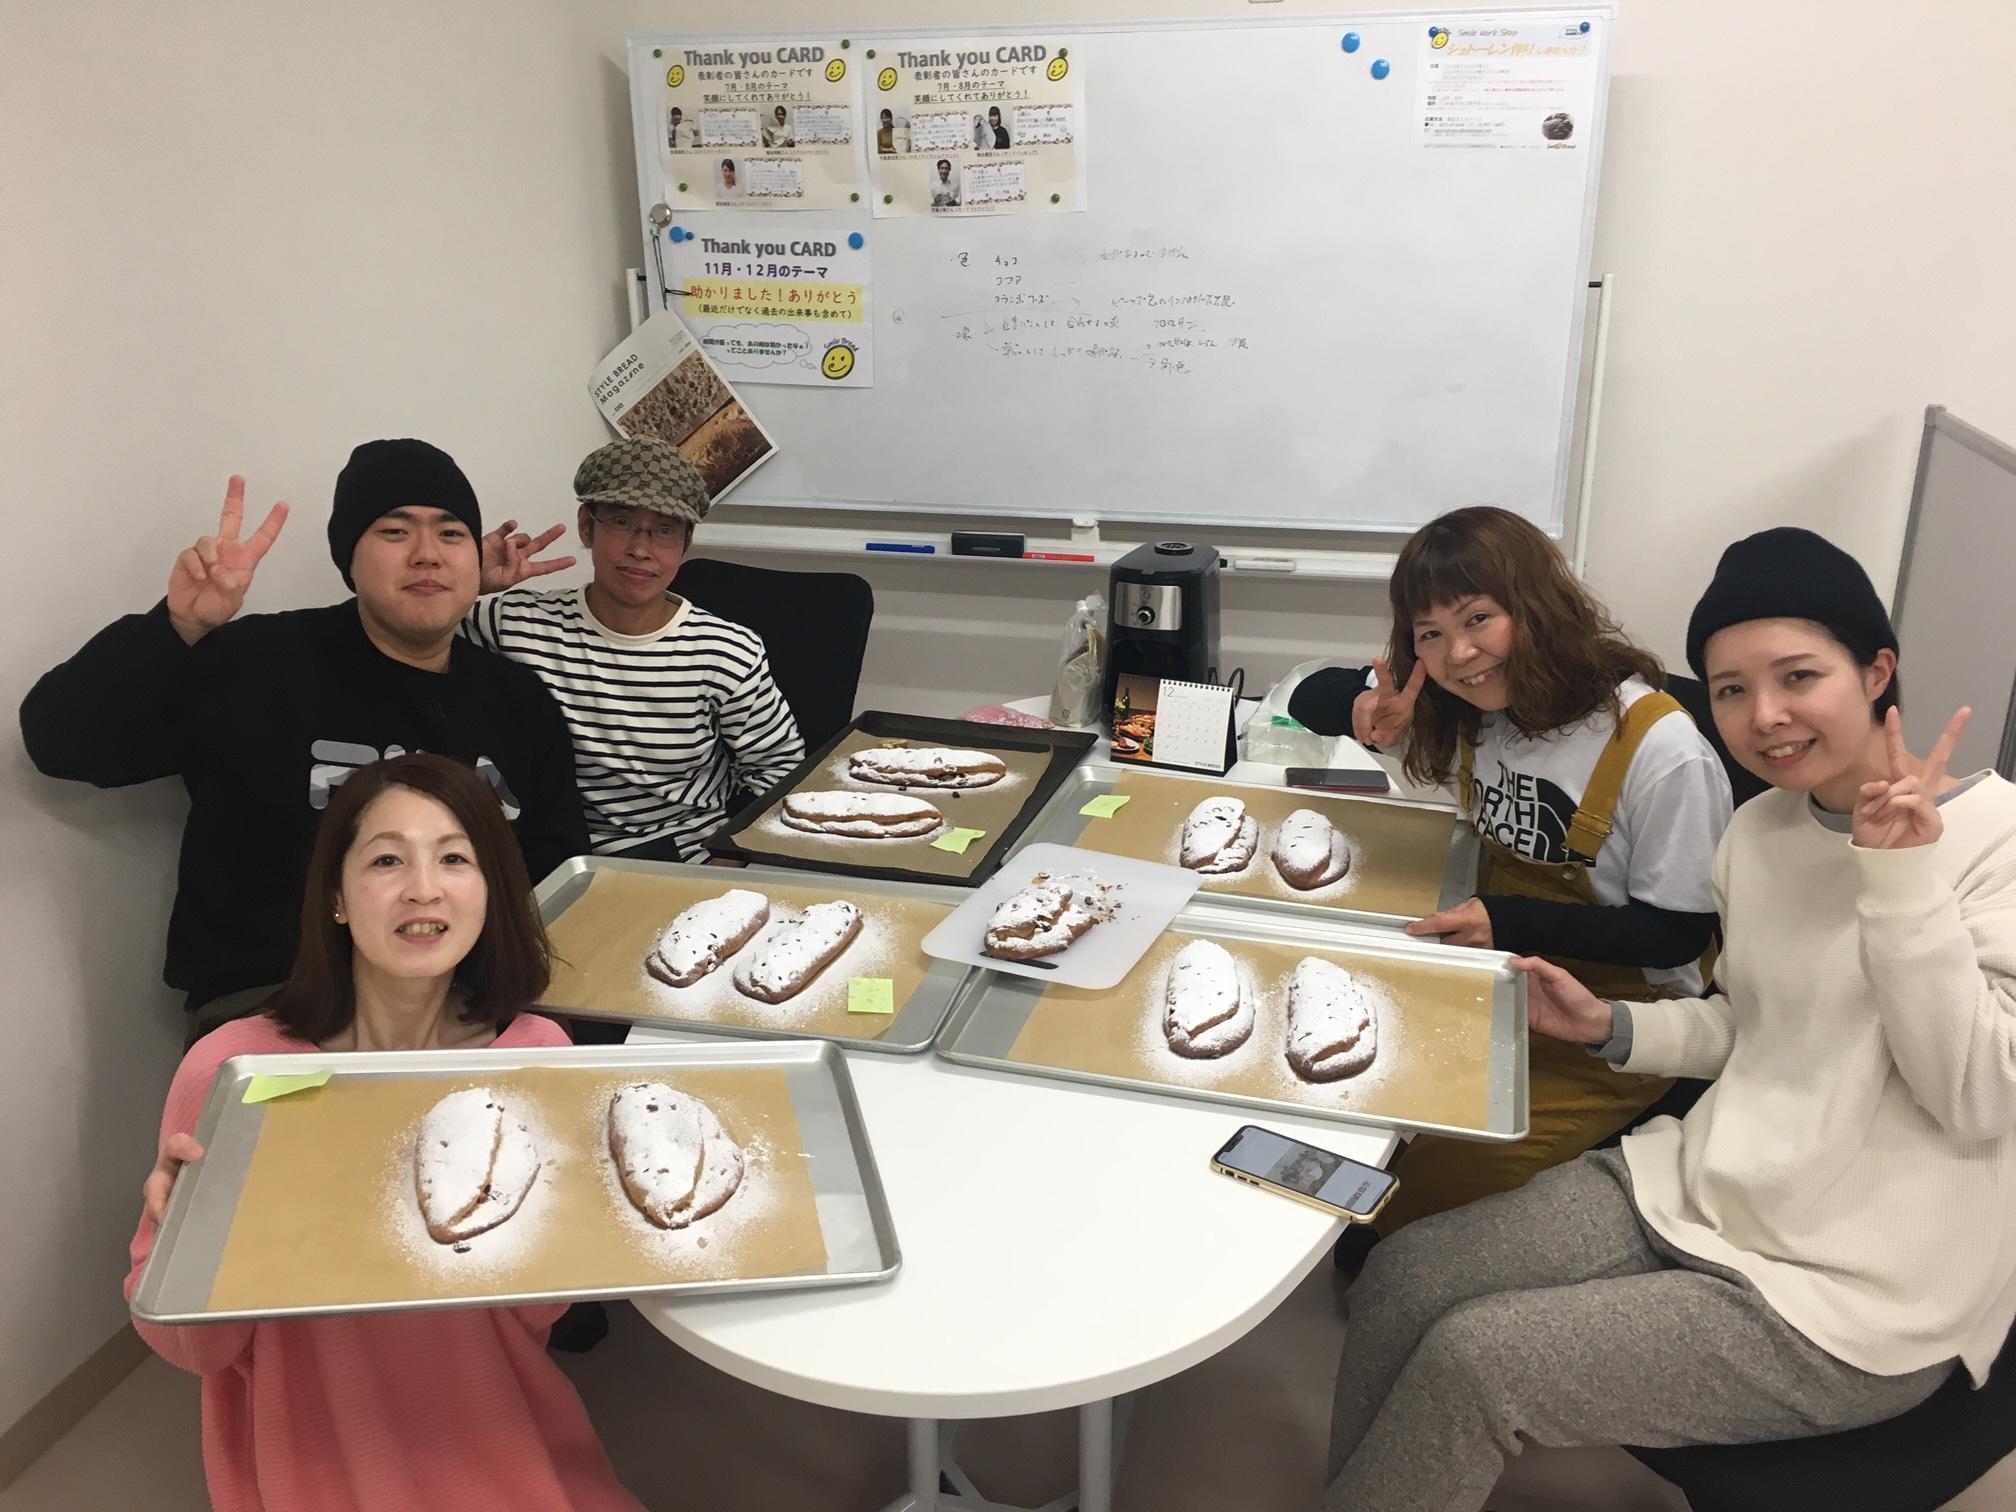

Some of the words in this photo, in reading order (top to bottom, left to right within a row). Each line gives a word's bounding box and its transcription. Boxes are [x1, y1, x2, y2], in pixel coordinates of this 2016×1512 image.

[684, 49, 735, 67] Thank
[740, 50, 772, 68] you
[776, 46, 826, 64] CARD
[897, 49, 951, 69] Thank
[956, 50, 991, 69] you
[996, 45, 1047, 63] CARD
[697, 68, 814, 81] 表彰者の皆さんのカードです
[914, 65, 1037, 81] 表彰者の皆さんのカードです
[701, 238, 751, 255] Thank
[755, 242, 786, 258] you
[790, 241, 837, 257] CARD
[690, 285, 857, 305] 助かりました！ありがとう
[594, 374, 616, 398] STYLE
[612, 353, 639, 379] BREAD
[1162, 686, 1176, 698] 12
[1496, 760, 1534, 801] THE
[1476, 805, 1534, 857] FACE
